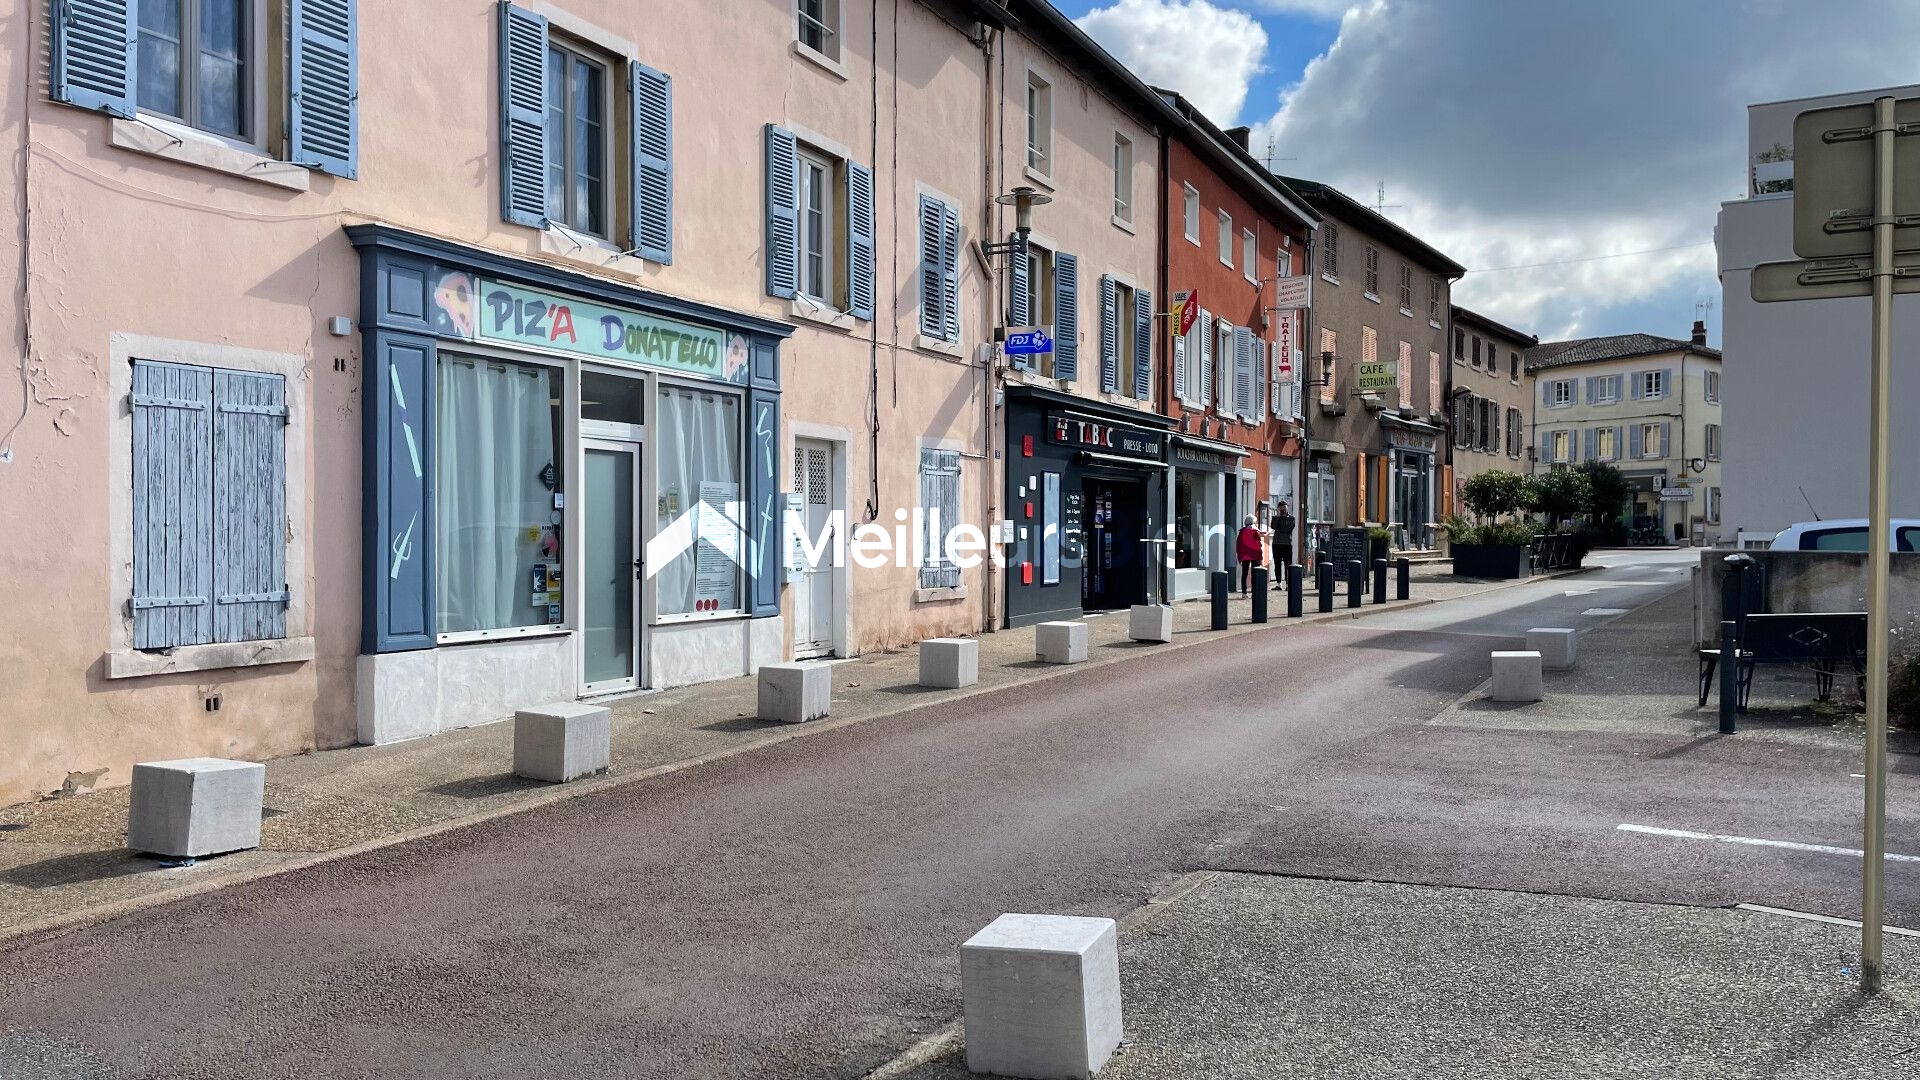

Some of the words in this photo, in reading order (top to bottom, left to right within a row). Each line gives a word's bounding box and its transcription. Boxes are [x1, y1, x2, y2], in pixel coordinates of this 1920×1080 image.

[1174, 292, 1187, 300] VAPE
[485, 291, 577, 344] PIZ'A
[1010, 335, 1030, 345] FDJ
[1281, 316, 1290, 364] TRAITEUR
[1360, 364, 1384, 375] CAFE
[1359, 376, 1397, 388] RESTAURANT
[1077, 421, 1114, 448] TABAC
[1123, 438, 1142, 452] PRESSE
[1145, 442, 1158, 454] LOTO
